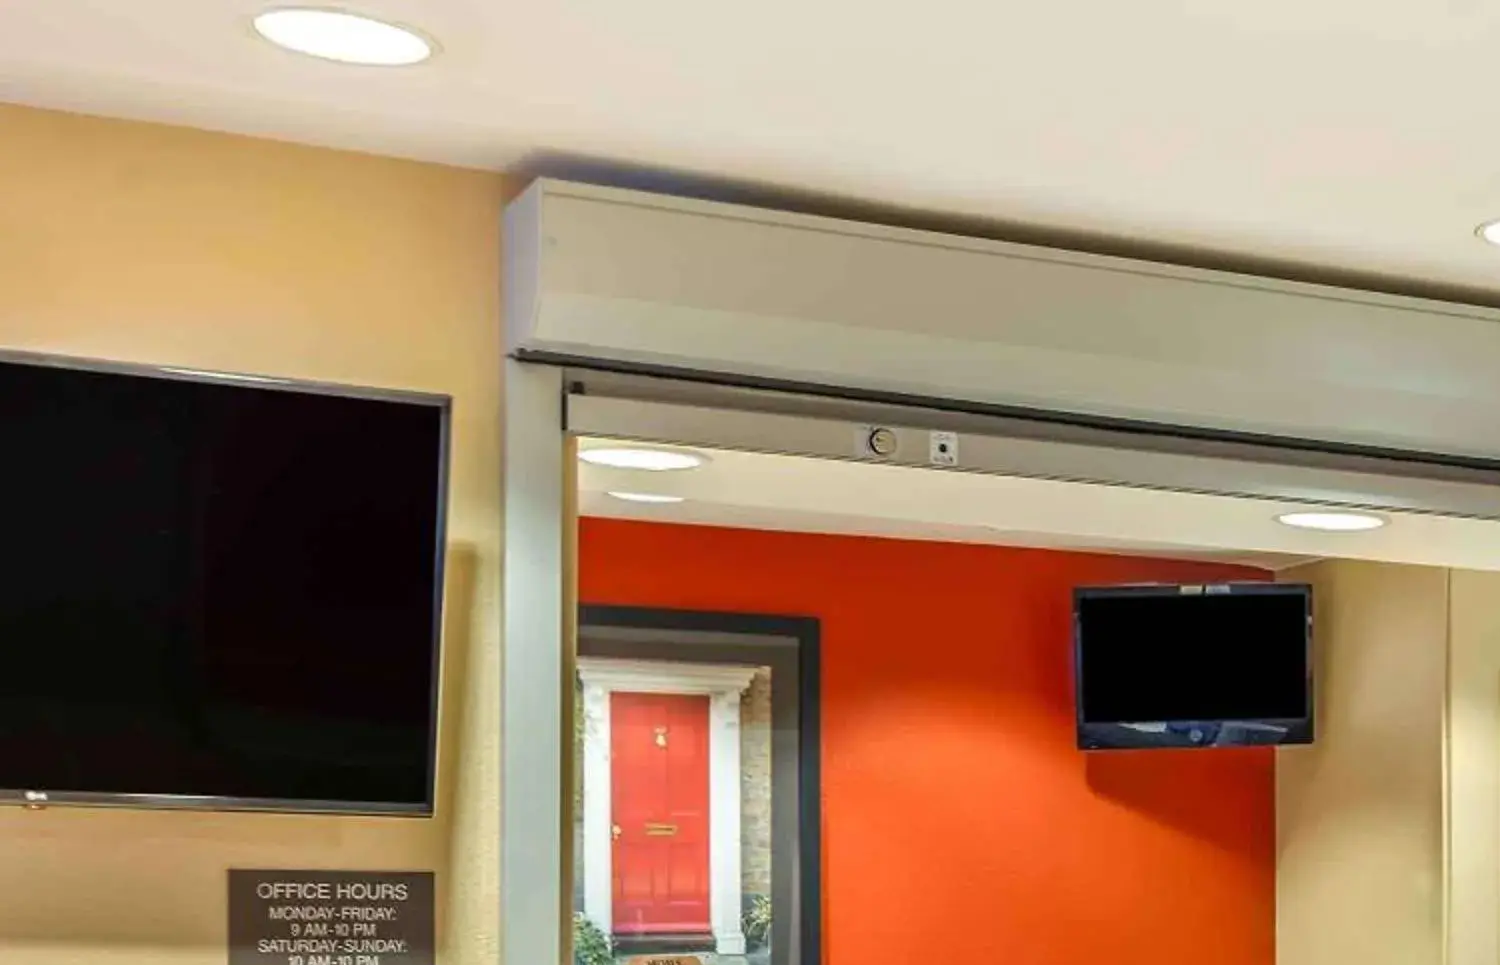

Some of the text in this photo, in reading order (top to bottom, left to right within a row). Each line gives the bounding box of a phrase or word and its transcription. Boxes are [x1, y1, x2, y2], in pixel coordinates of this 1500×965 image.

[256, 882, 409, 901] OFFICE HOURS
[269, 905, 398, 921] MONDAY-FRIDAY:
[290, 923, 377, 937] 9 AM-10 PM
[258, 939, 408, 954] SATURDAY-SUNDAY:
